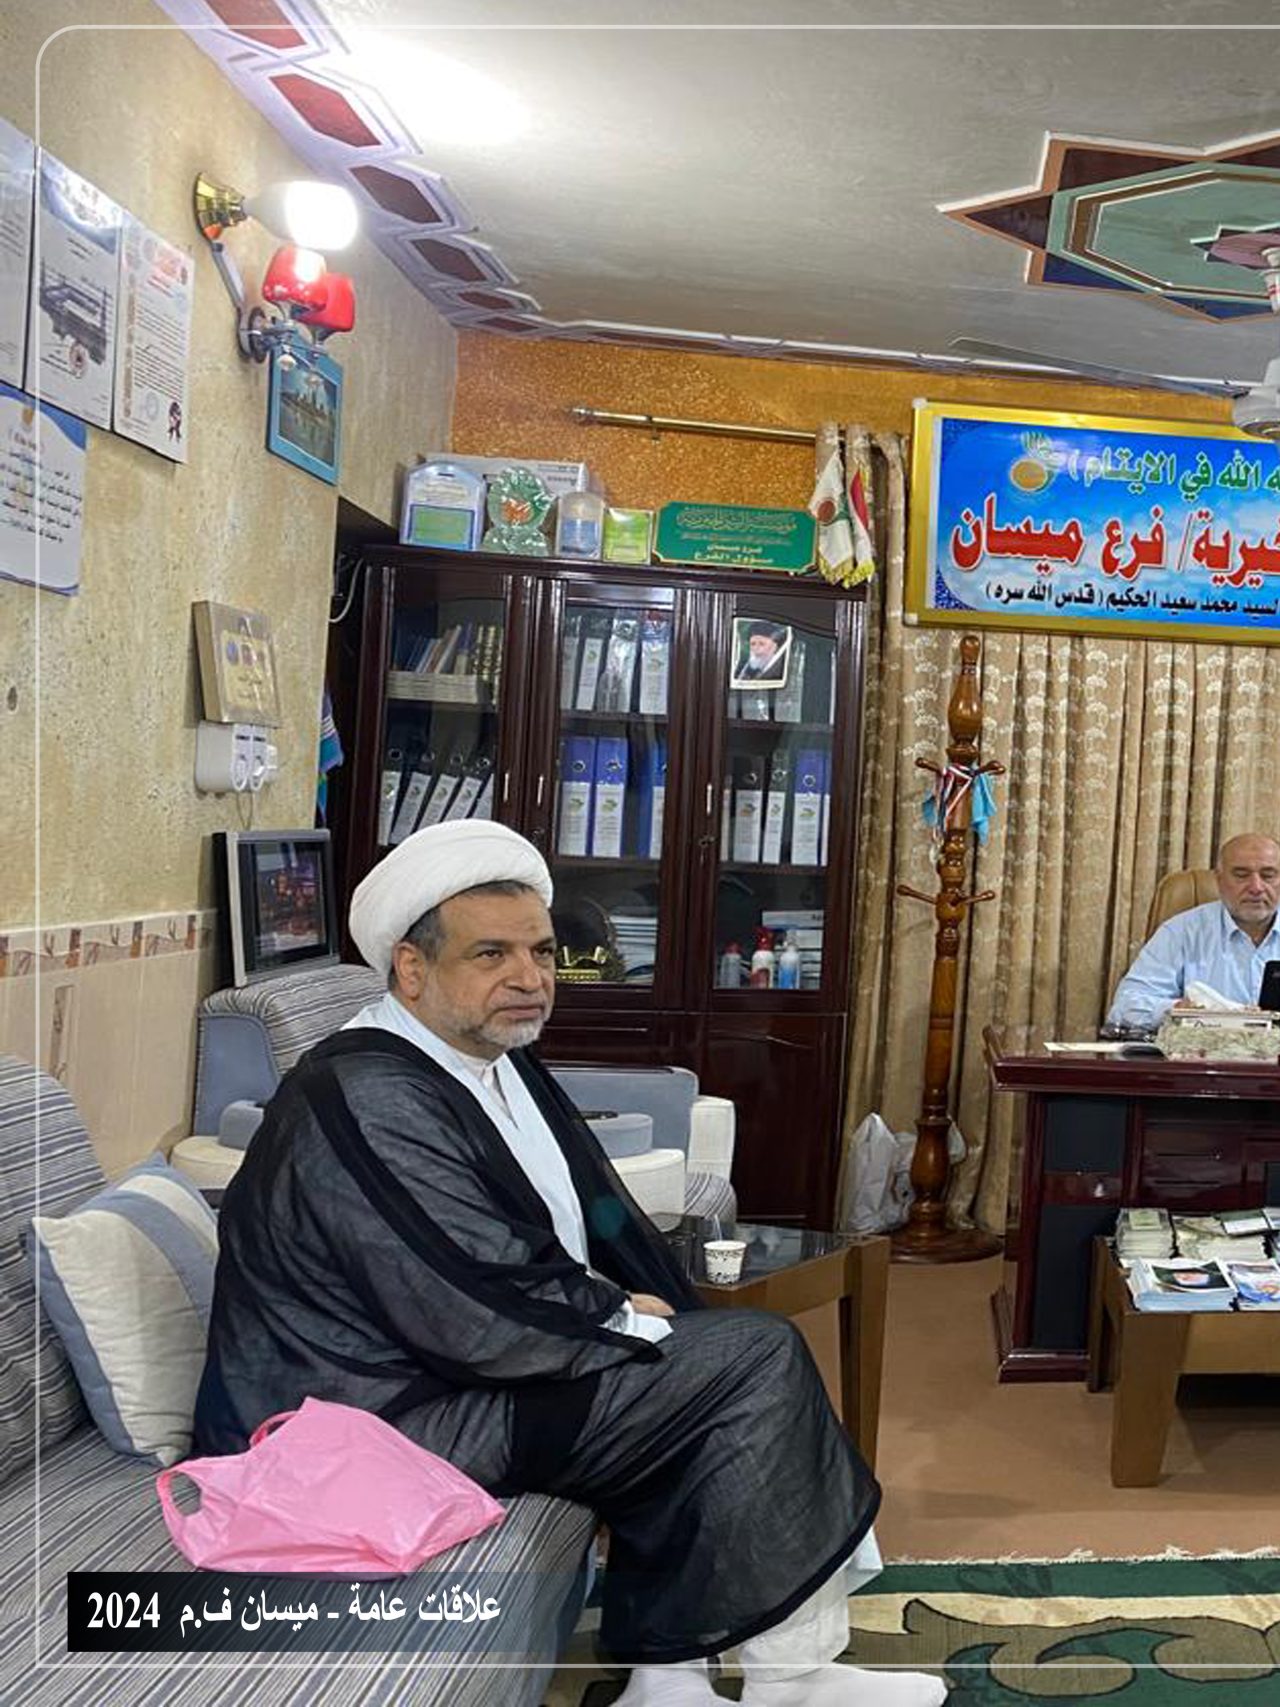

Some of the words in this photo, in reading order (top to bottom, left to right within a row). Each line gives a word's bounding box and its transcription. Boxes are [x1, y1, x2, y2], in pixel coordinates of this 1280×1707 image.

[1179, 452, 1213, 501] في
[1217, 450, 1261, 491] الله
[951, 493, 1085, 575] ميسان
[1101, 506, 1166, 580] فرع
[1028, 582, 1053, 602] الله
[1106, 587, 1157, 611] الحكيم
[1161, 594, 1197, 616] سعيد
[1201, 596, 1238, 613] محمد
